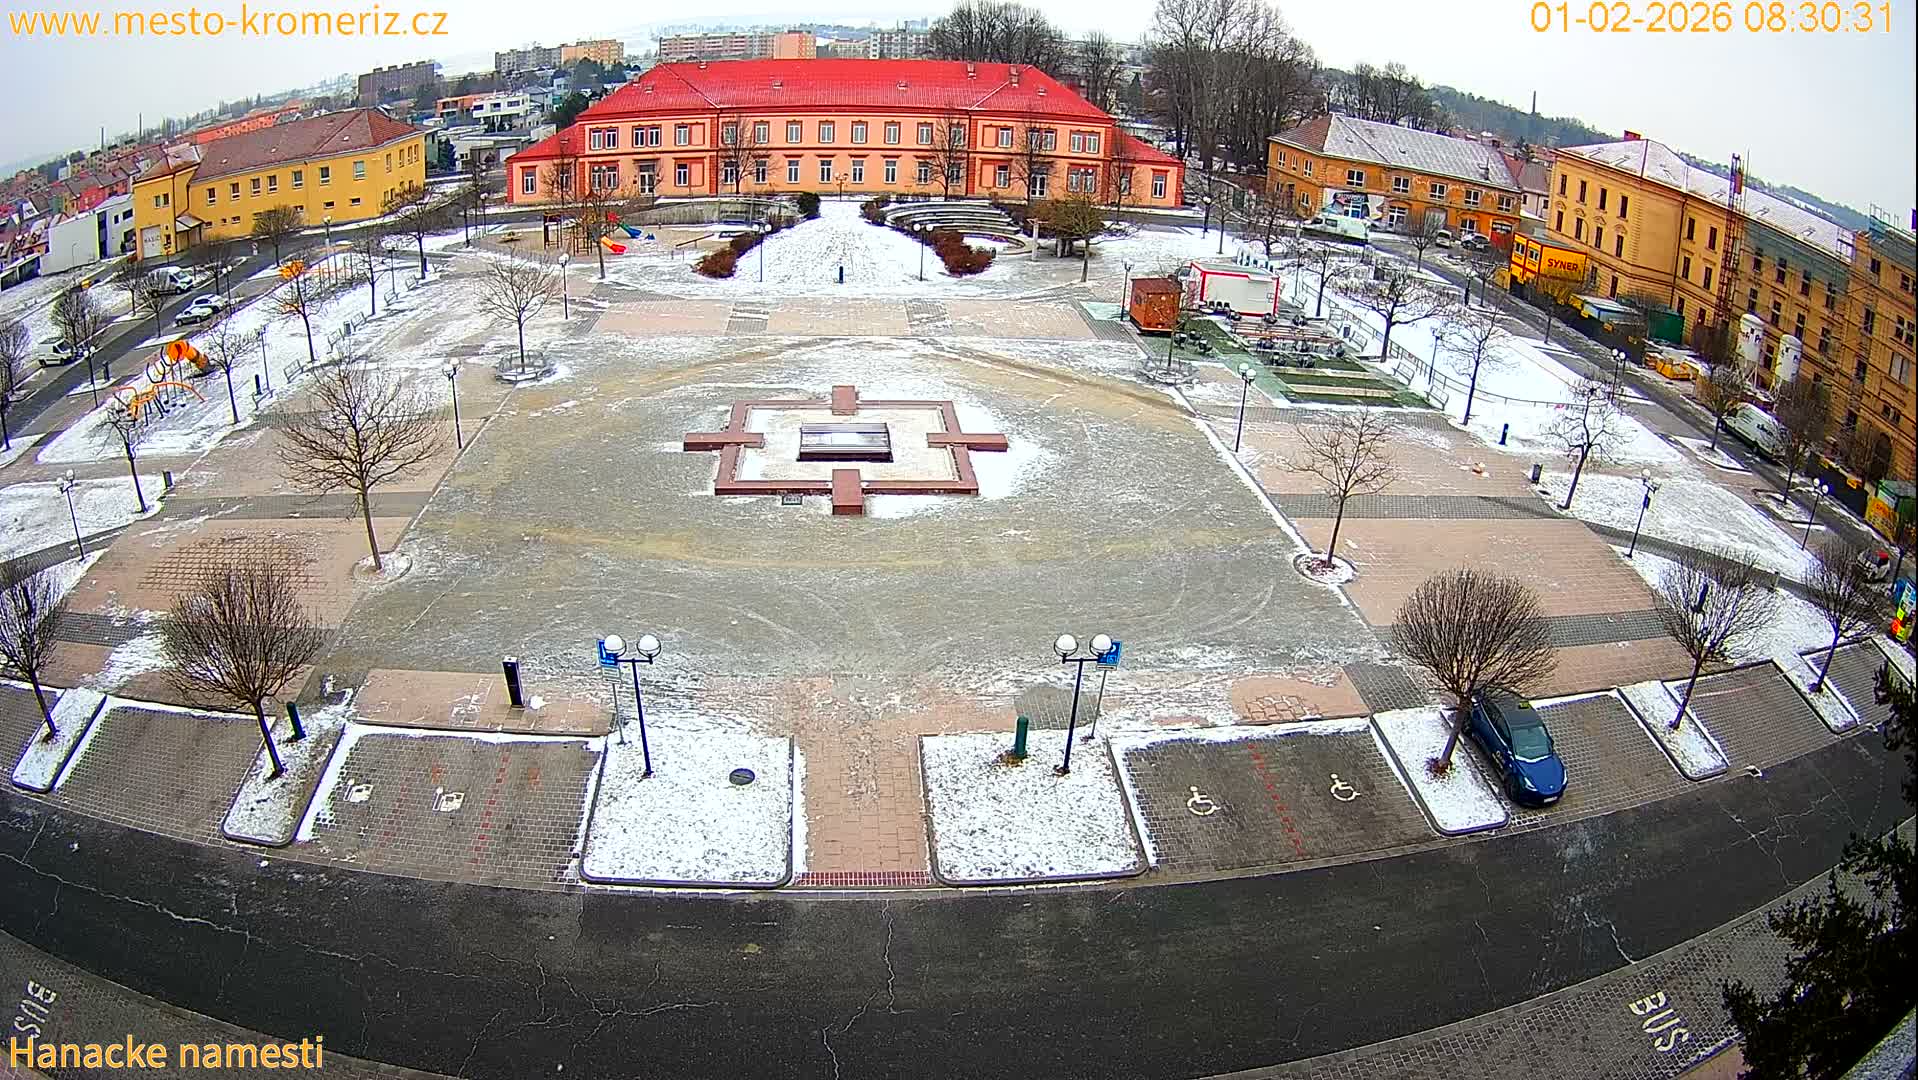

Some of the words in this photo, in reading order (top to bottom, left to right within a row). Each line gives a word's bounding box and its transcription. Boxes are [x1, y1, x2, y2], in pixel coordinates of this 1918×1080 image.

[1547, 258, 1579, 272] SYNER
[14, 980, 57, 1039] BUS
[1628, 991, 1689, 1052] BUS
